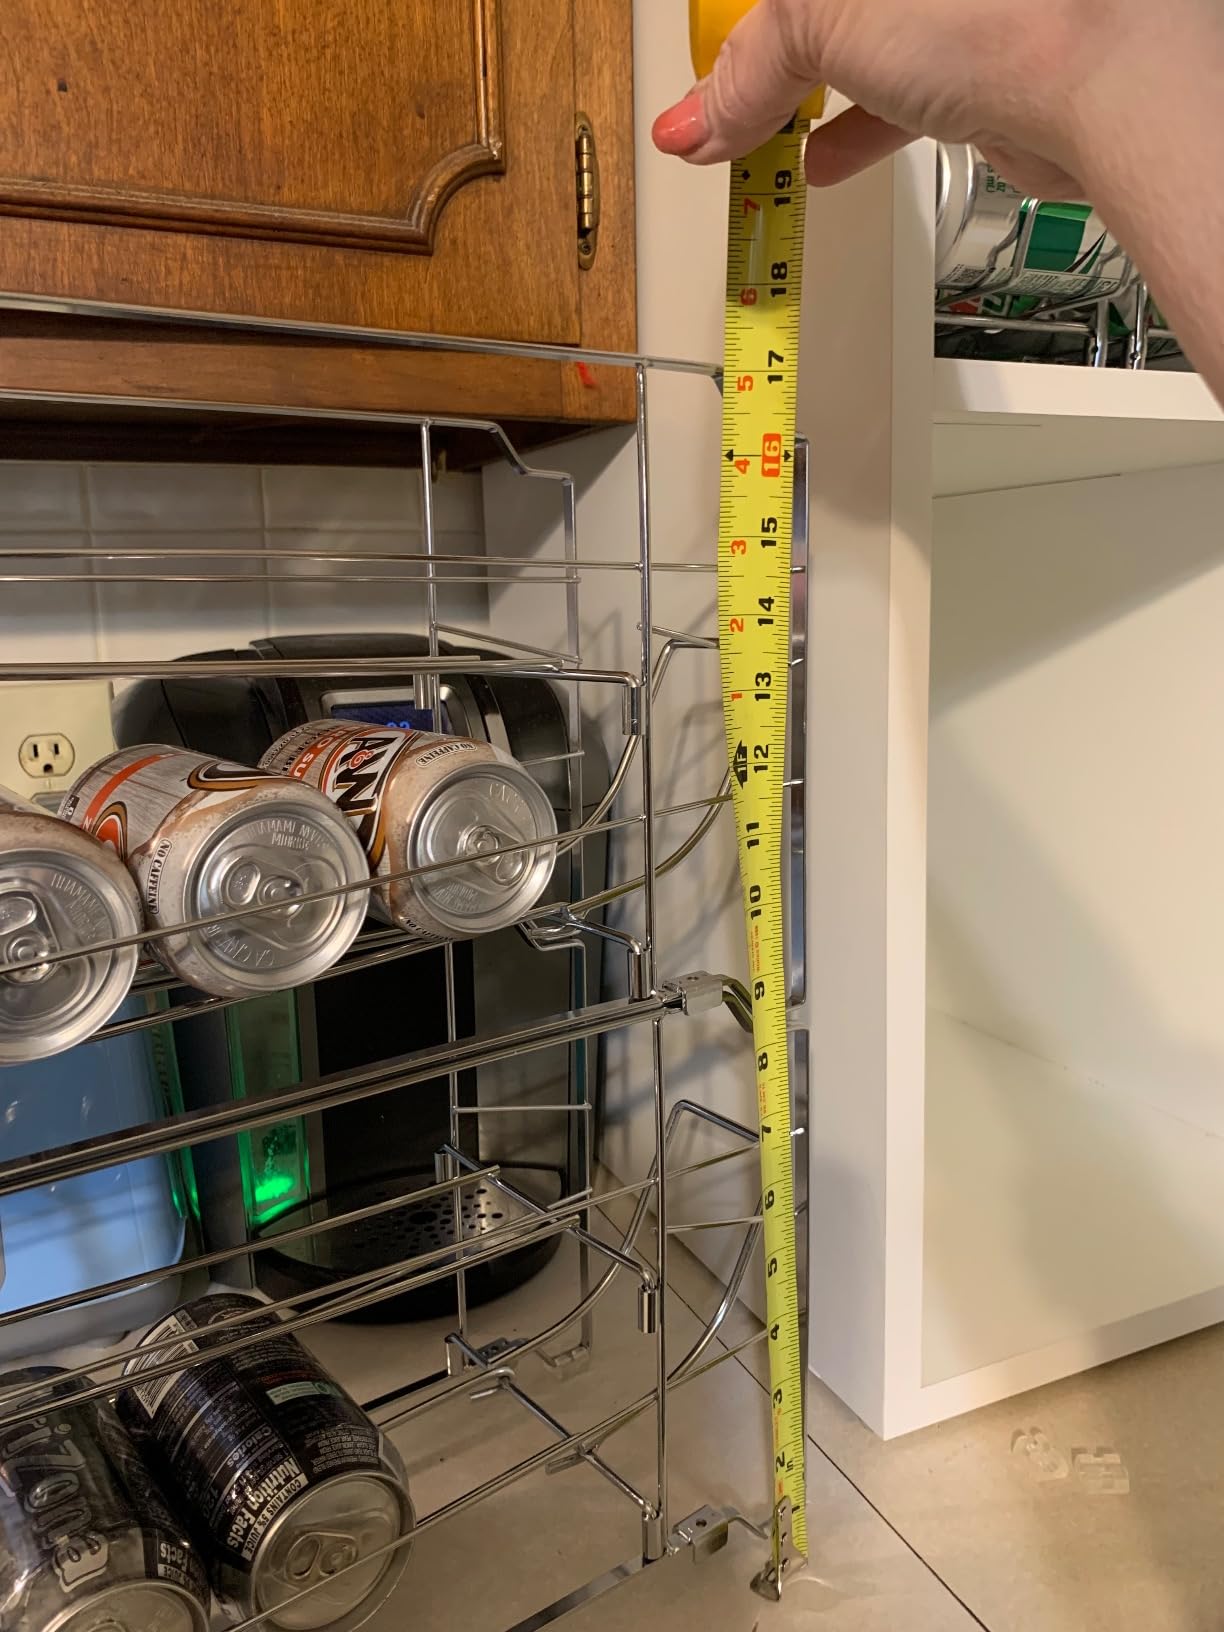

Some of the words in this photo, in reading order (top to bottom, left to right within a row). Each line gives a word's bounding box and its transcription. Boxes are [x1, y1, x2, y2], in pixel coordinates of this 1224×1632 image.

[774, 170, 792, 207] 19
[743, 198, 760, 217] 7
[771, 262, 788, 297] 18
[767, 350, 784, 384] 17
[737, 375, 754, 391] 5
[734, 458, 750, 474] 4
[762, 437, 780, 476] 16
[761, 517, 778, 548] 15
[731, 539, 747, 555] 3
[758, 596, 775, 626] 14
[729, 618, 744, 632] 2
[731, 692, 743, 701] 1
[755, 672, 772, 702] 13
[754, 744, 769, 773] 12
[334, 736, 400, 817] A&W
[746, 822, 760, 849] 11
[157, 843, 170, 858] NO
[148, 859, 162, 912] CAFFEINE
[750, 884, 761, 920] 10
[754, 981, 765, 1000] 9
[758, 1052, 769, 1072] 8
[761, 1125, 772, 1142] 7
[765, 1190, 775, 1210] 6
[768, 1257, 778, 1278] 5
[770, 1323, 780, 1340] 4
[773, 1388, 783, 1409] 3
[226, 1425, 272, 1469] Calories
[246, 1457, 299, 1512] Nutrition
[264, 1478, 303, 1515] CONTAINS
[225, 1508, 256, 1549] Facts
[257, 1514, 271, 1528] 5%
[244, 1528, 262, 1555] JUICE
